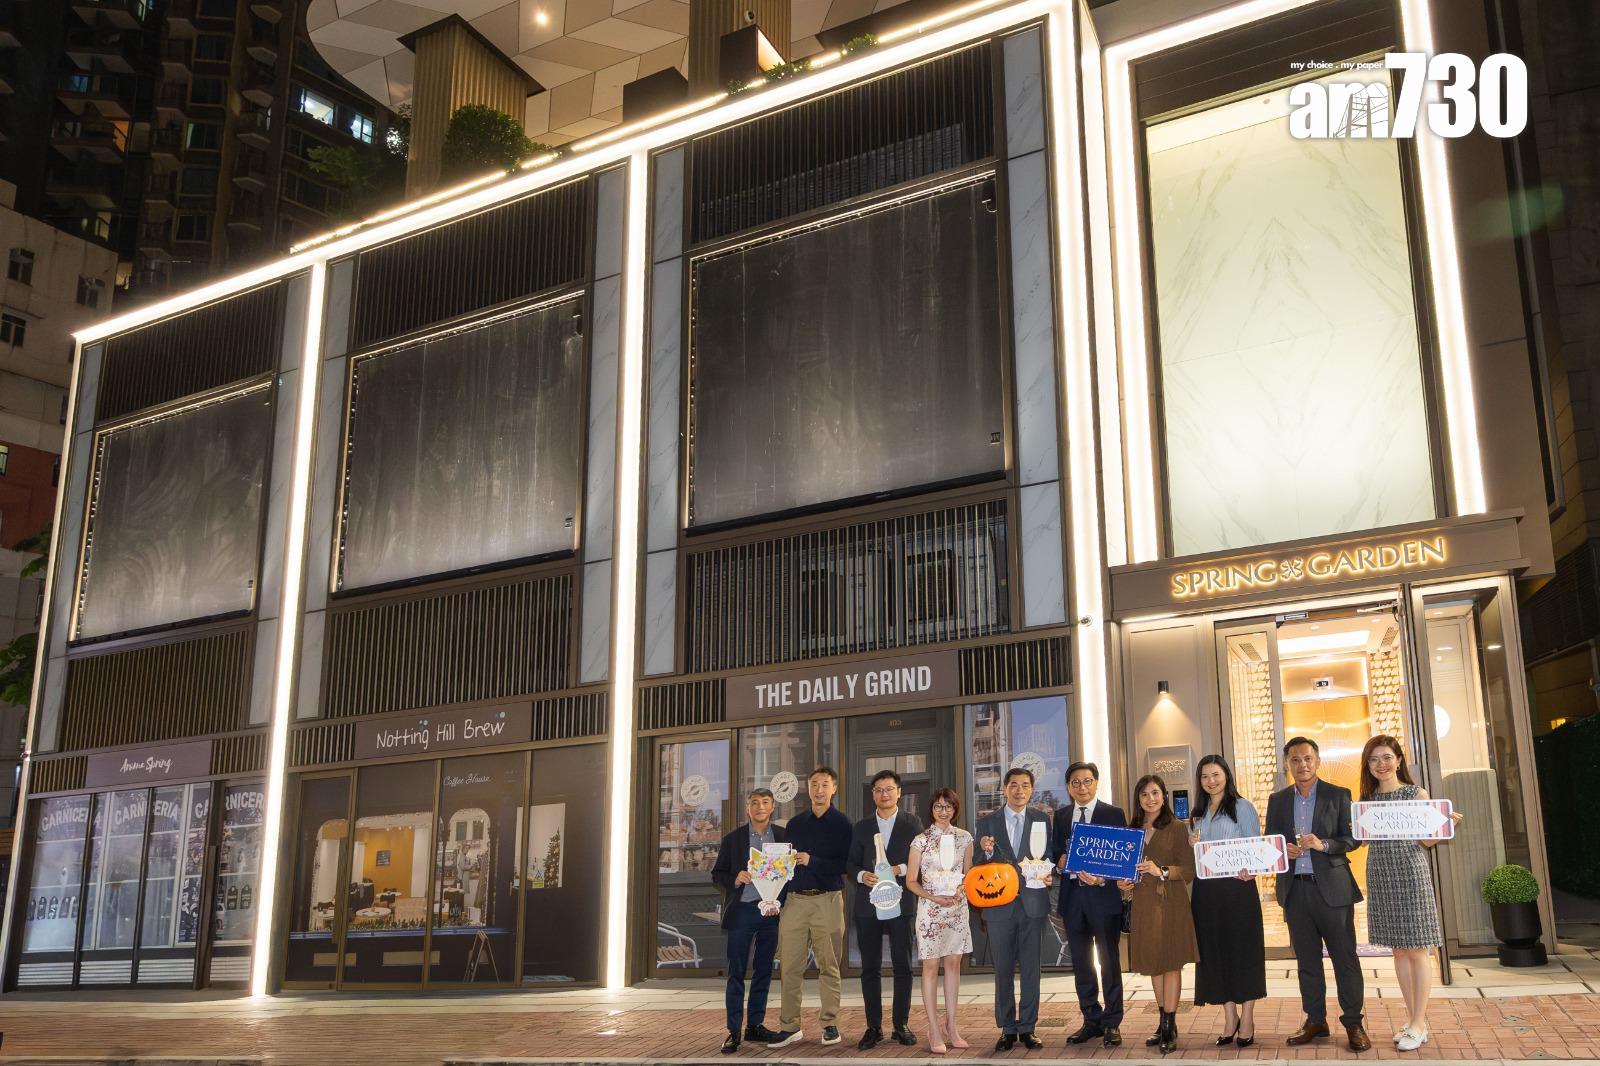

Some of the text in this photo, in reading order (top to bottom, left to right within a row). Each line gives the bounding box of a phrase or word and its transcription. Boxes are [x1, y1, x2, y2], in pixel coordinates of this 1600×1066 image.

[1172, 537, 1445, 596] SPRING GARDEN
[755, 665, 931, 709] THE DAILY GRIND
[376, 718, 505, 750] Notting Hill Brew
[145, 756, 172, 774] Spring
[466, 772, 490, 785] House
[1374, 811, 1419, 821] SPRING
[1373, 820, 1427, 831] GARDEN
[1079, 836, 1124, 851] SPRING
[1076, 847, 1131, 861] GARDEN
[1214, 848, 1256, 859] SPRING
[1215, 857, 1264, 868] GARDEN
